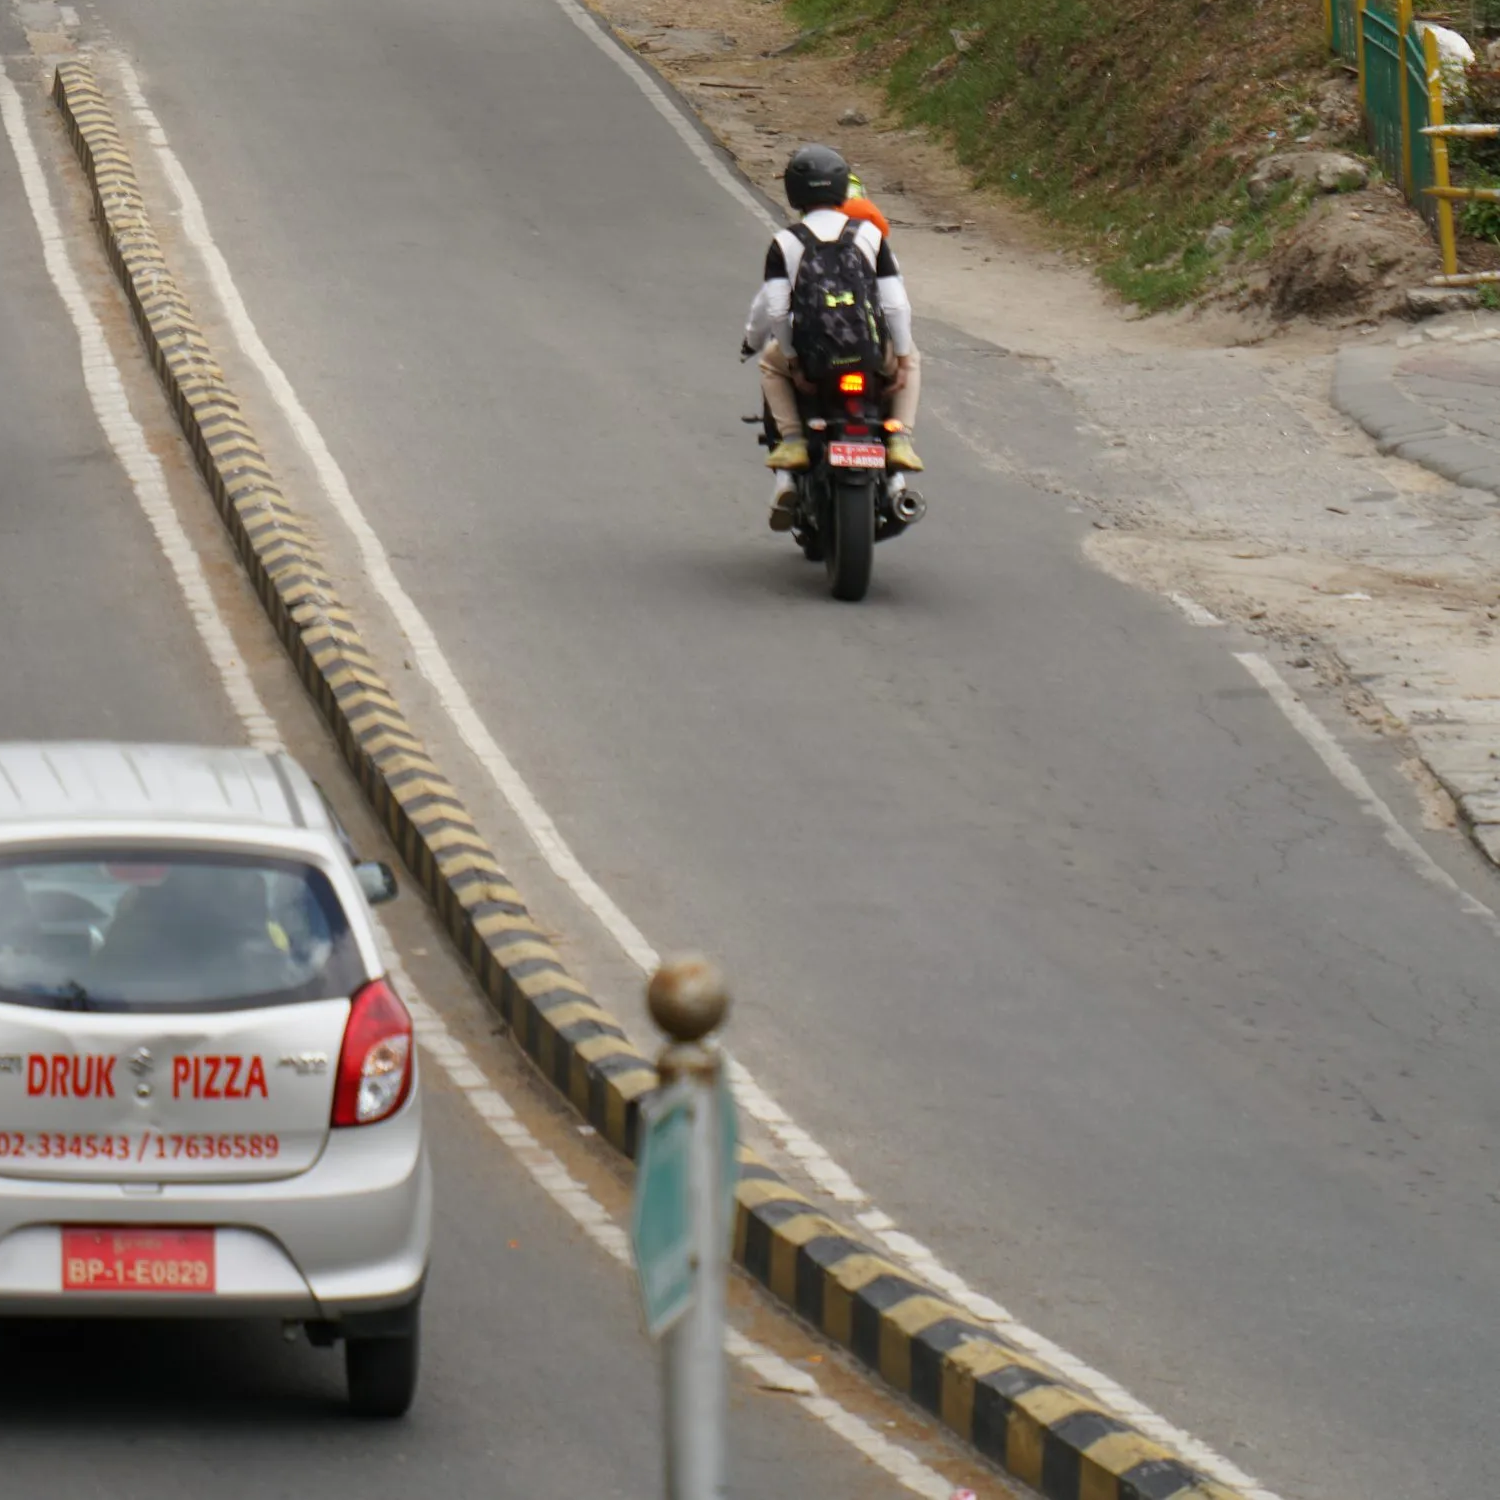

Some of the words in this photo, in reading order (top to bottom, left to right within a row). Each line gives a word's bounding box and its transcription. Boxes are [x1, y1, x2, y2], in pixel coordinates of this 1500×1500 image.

[26, 1053, 117, 1098] DRUK
[172, 1055, 268, 1099] PIZZA
[67, 1257, 209, 1286] BP-1-E0829
